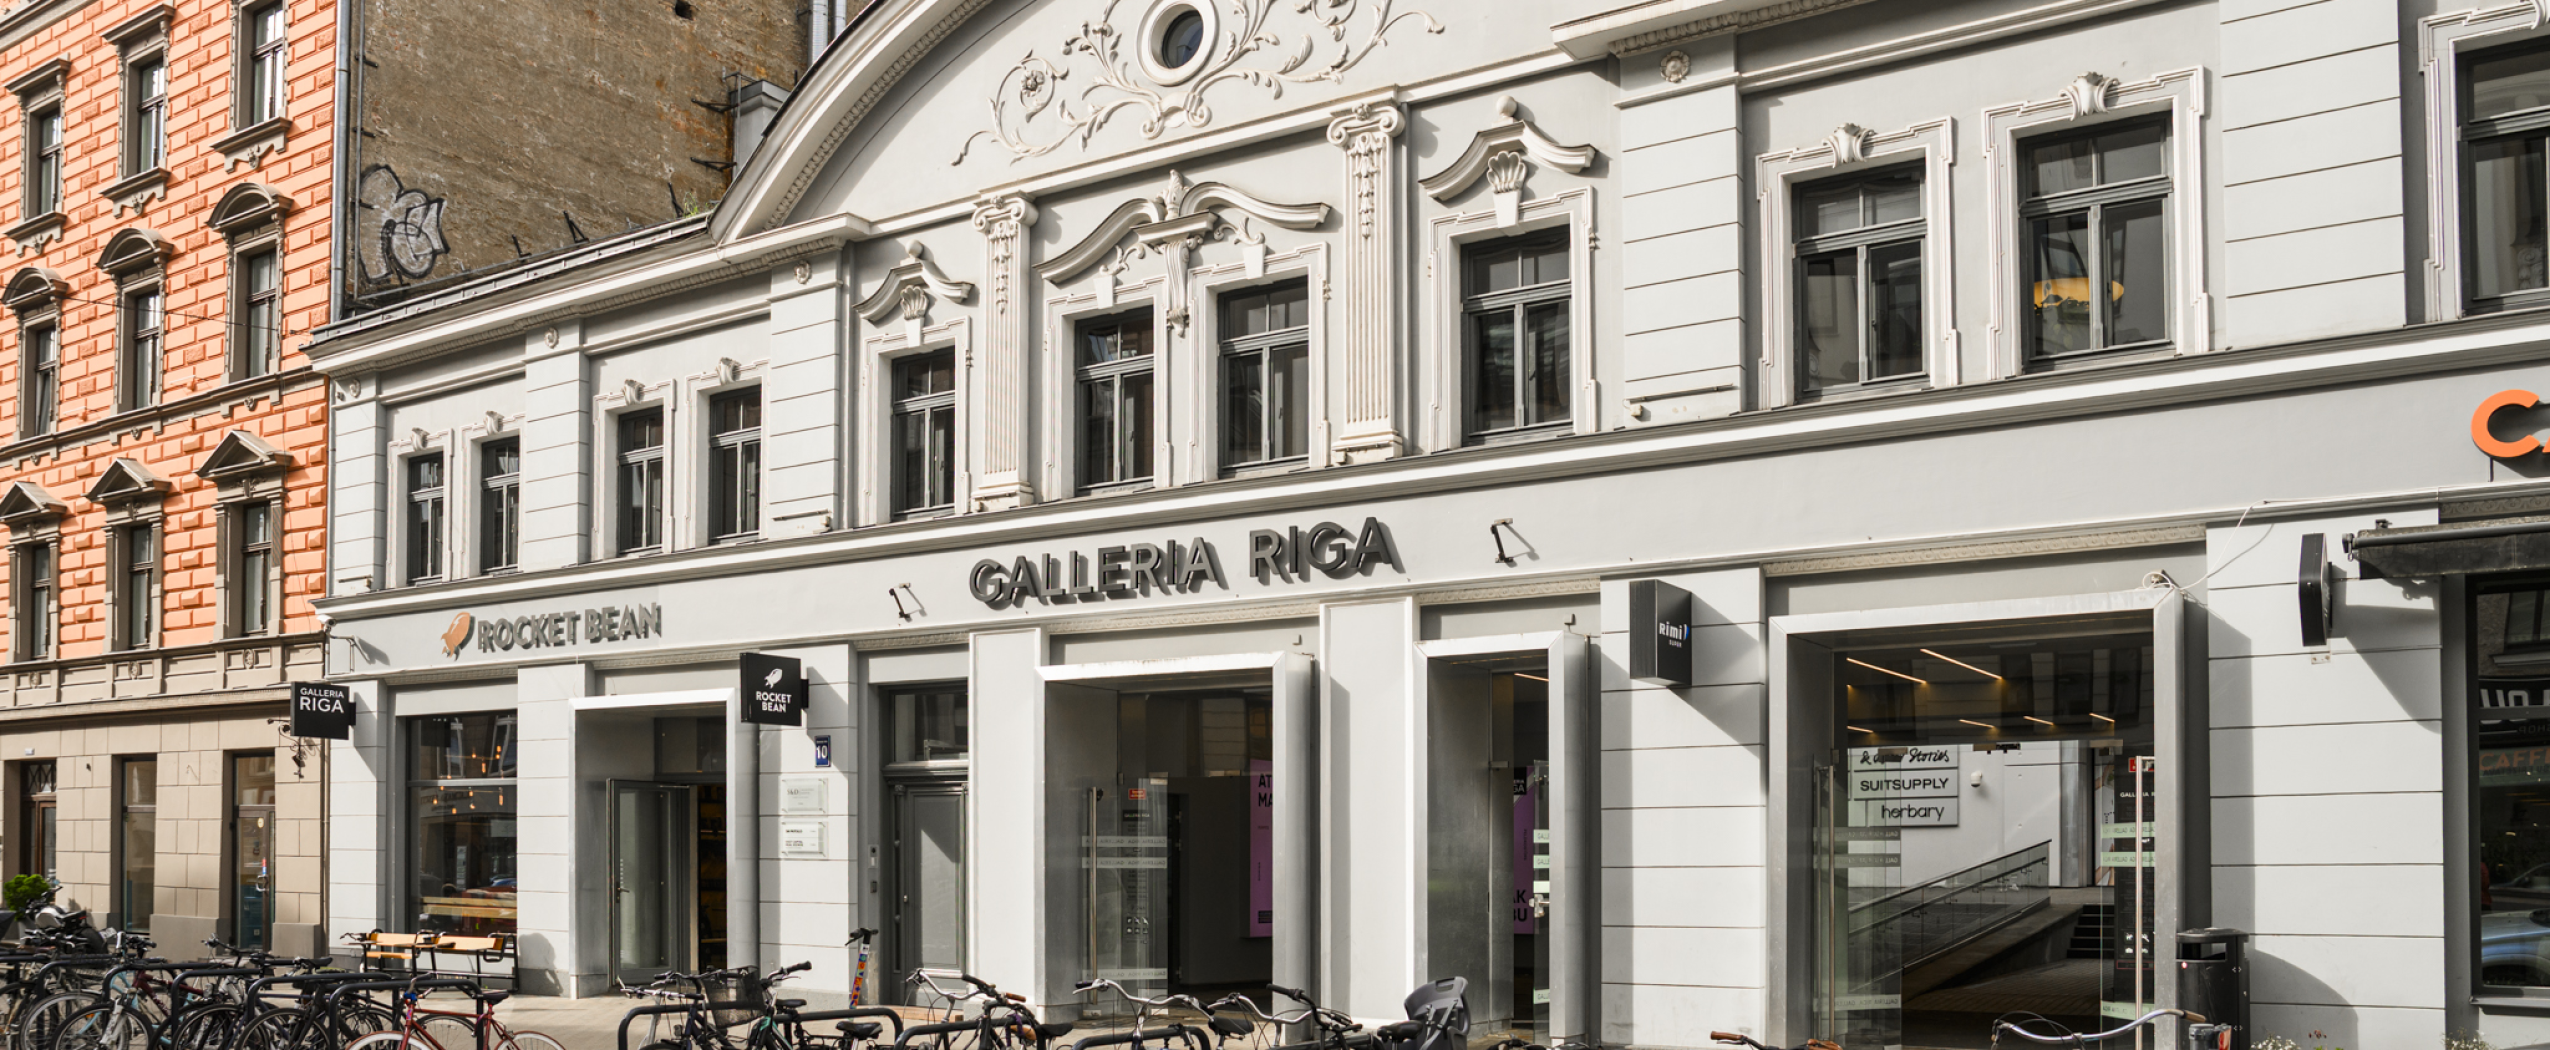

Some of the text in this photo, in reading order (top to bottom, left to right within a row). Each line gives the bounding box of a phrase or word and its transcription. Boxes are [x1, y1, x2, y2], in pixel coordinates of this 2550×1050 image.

[2471, 388, 2550, 457] C
[969, 516, 1395, 601] GALLERIA RIGA
[478, 602, 660, 651] ROCKET BEAN
[1659, 621, 1682, 640] Rimi
[300, 687, 344, 699] GALLERIA
[756, 691, 792, 704] ROCKET
[300, 696, 344, 713] RIGA
[762, 702, 787, 713] BEAN
[816, 745, 828, 759] 10
[1909, 747, 1950, 764] Stories
[1860, 778, 1949, 791] SUITSUPPLY
[1881, 804, 1945, 821] herbary
[1514, 889, 1527, 904] K
